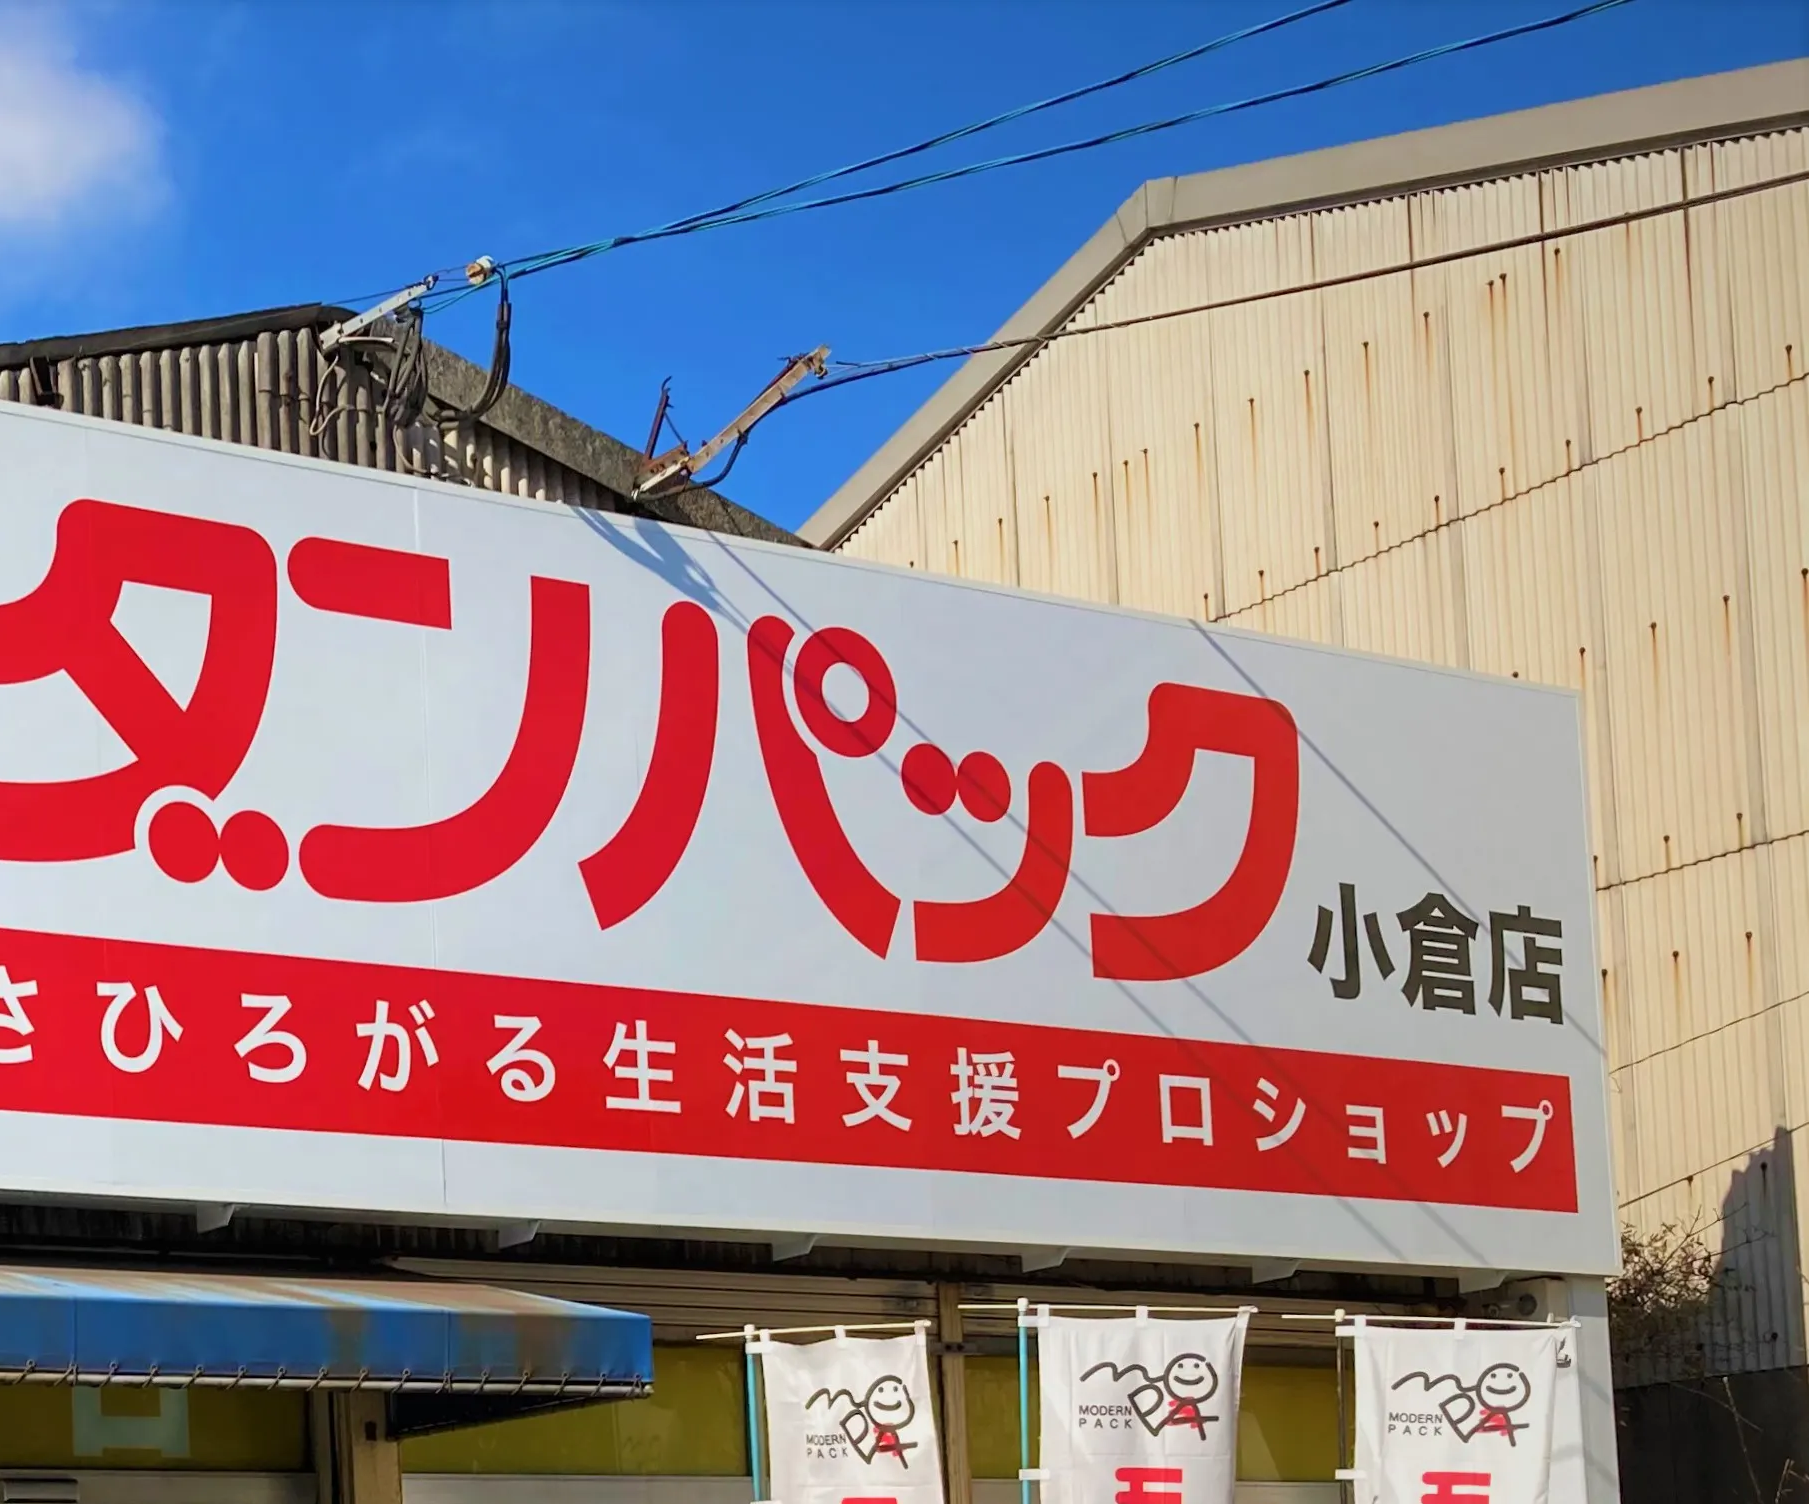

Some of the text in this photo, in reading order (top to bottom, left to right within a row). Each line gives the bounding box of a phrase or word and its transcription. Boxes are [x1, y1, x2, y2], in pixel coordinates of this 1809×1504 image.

[1308, 881, 1564, 1025] 小倉店
[1078, 1404, 1133, 1416] MODERN
[1078, 1417, 1133, 1429] PACK
[1388, 1411, 1444, 1424] MODERN
[1387, 1423, 1443, 1436] PACK
[805, 1433, 847, 1446] MODERN
[805, 1447, 849, 1459] PACK
